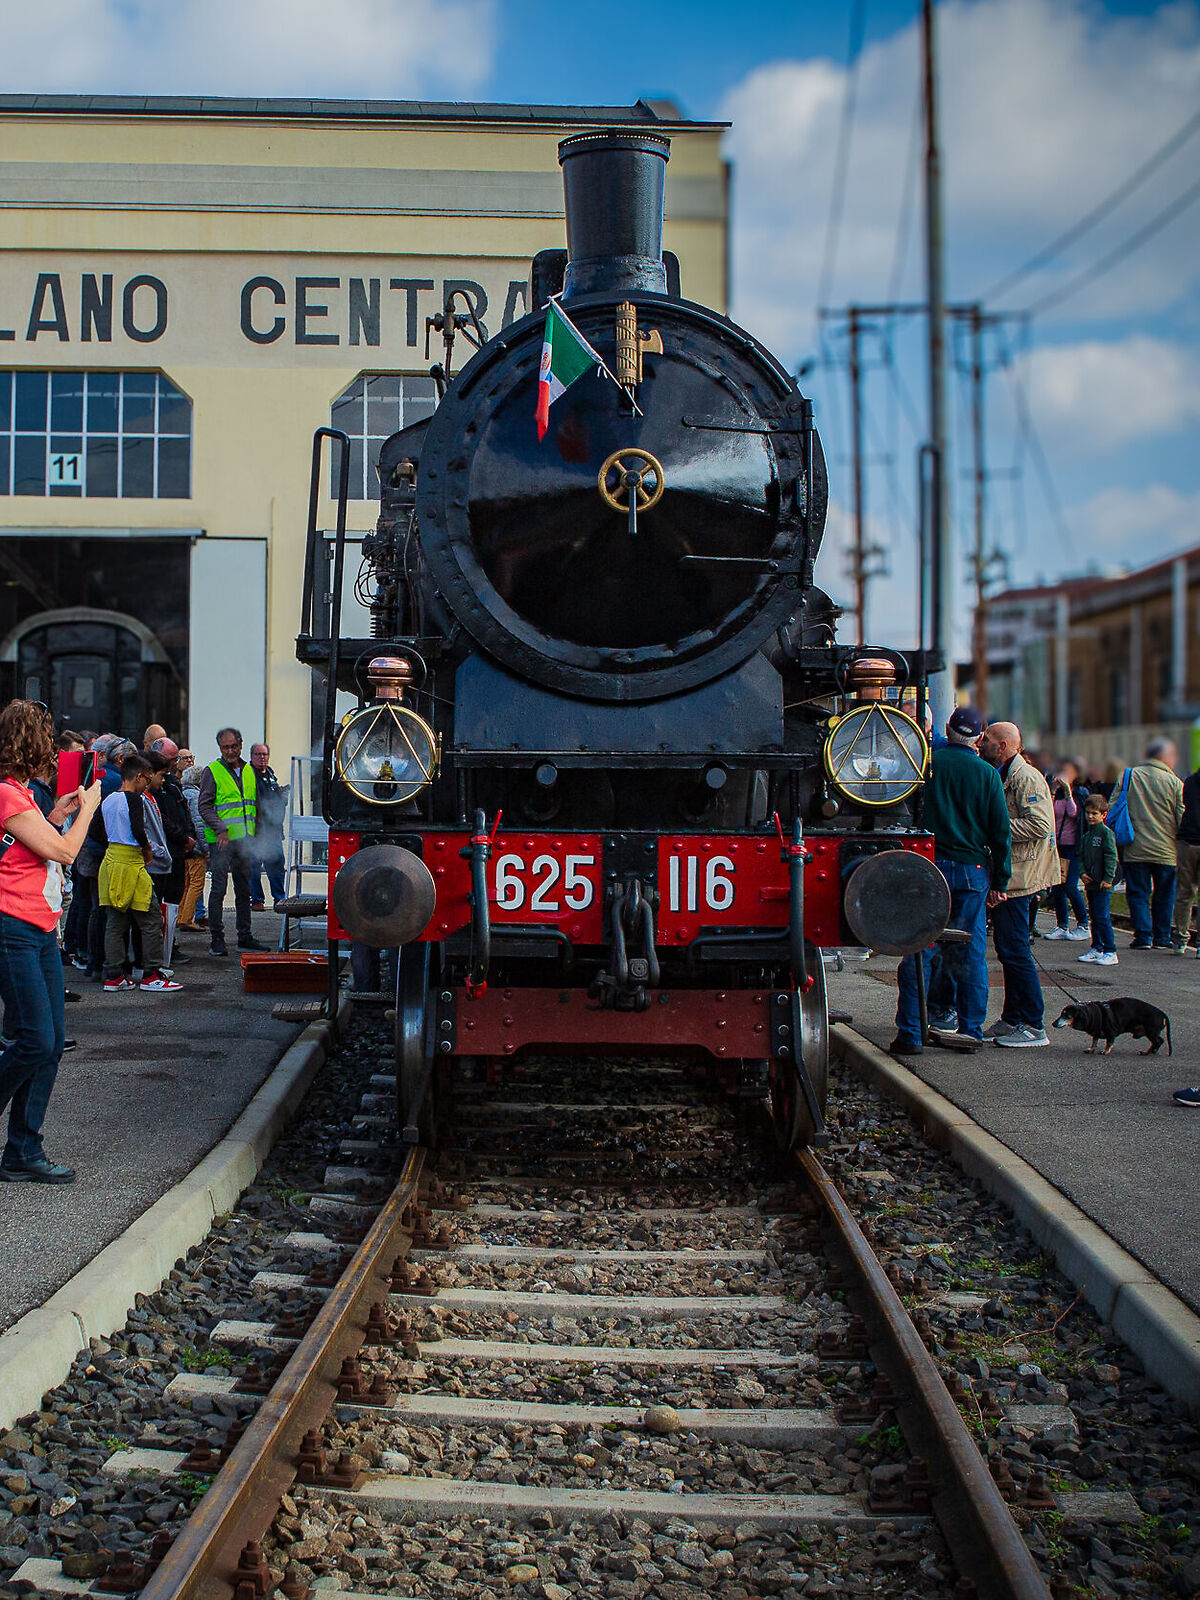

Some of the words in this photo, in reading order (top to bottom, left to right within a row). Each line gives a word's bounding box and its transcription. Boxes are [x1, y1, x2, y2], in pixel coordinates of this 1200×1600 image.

[52, 455, 79, 480] 11
[495, 854, 596, 911] 625
[668, 855, 736, 911] 116
